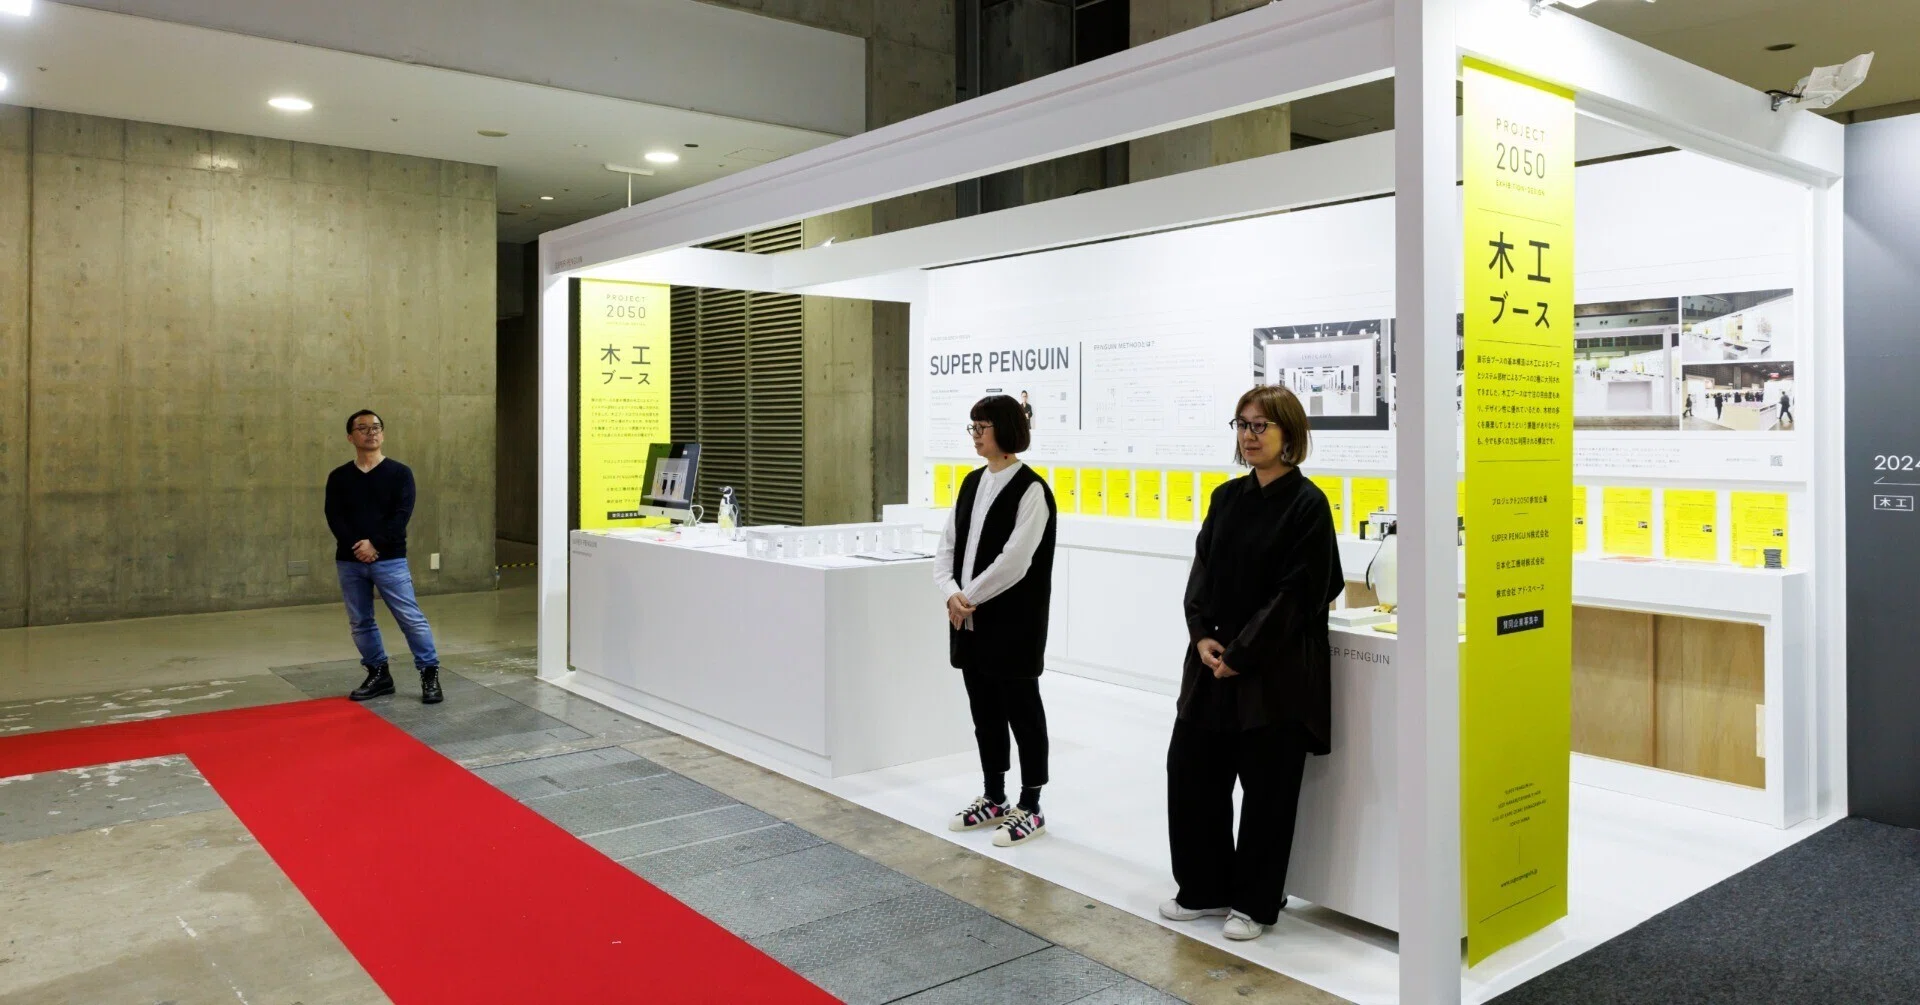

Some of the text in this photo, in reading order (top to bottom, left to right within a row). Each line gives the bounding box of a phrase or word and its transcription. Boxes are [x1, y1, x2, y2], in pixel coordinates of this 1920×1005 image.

[1496, 116, 1545, 142] PROJECT
[1496, 142, 1545, 179] 2050
[1488, 231, 1551, 283] 木工
[606, 294, 646, 302] PROJECT
[606, 304, 646, 319] 2050
[1489, 291, 1550, 328] ブース
[600, 343, 651, 365] 木工
[930, 352, 983, 376] SUPER
[989, 346, 1069, 373] PENGUIN
[601, 369, 651, 385] ブース
[1879, 497, 1907, 508] 木工
[1344, 648, 1390, 665] PENGUIN
